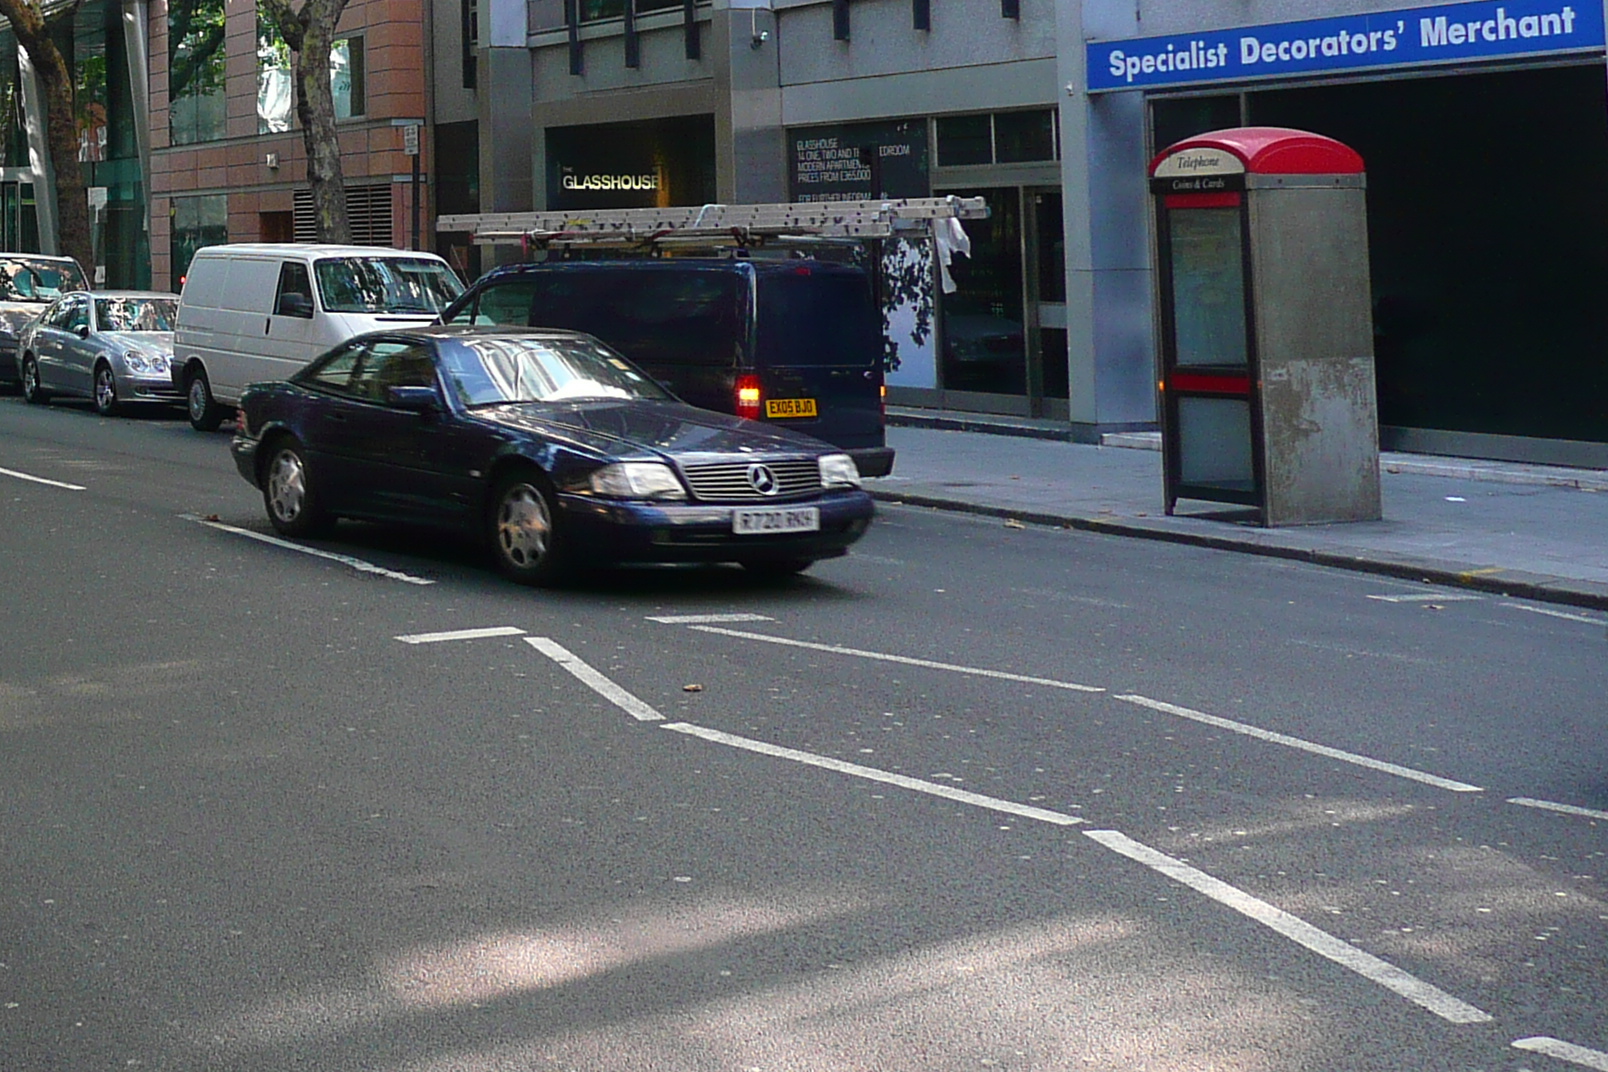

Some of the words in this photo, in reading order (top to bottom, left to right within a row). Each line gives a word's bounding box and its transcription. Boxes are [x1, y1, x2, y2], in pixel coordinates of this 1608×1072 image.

[1108, 42, 1228, 83] Specialist
[1240, 22, 1406, 66] Decorators'
[1420, 6, 1576, 48] Merchant
[797, 138, 838, 151] GLASSHOUSE
[822, 149, 837, 159] TWO
[838, 148, 852, 158] AND
[879, 144, 910, 157] EDROOM
[797, 160, 826, 172] MODERN
[1177, 155, 1220, 170] Telephone
[563, 175, 660, 190] GLASSHOUSE
[797, 172, 819, 183] PRICES
[820, 171, 839, 182] FROM
[1173, 179, 1192, 190] Coins
[1194, 179, 1201, 189] &
[1202, 177, 1225, 188] Cards
